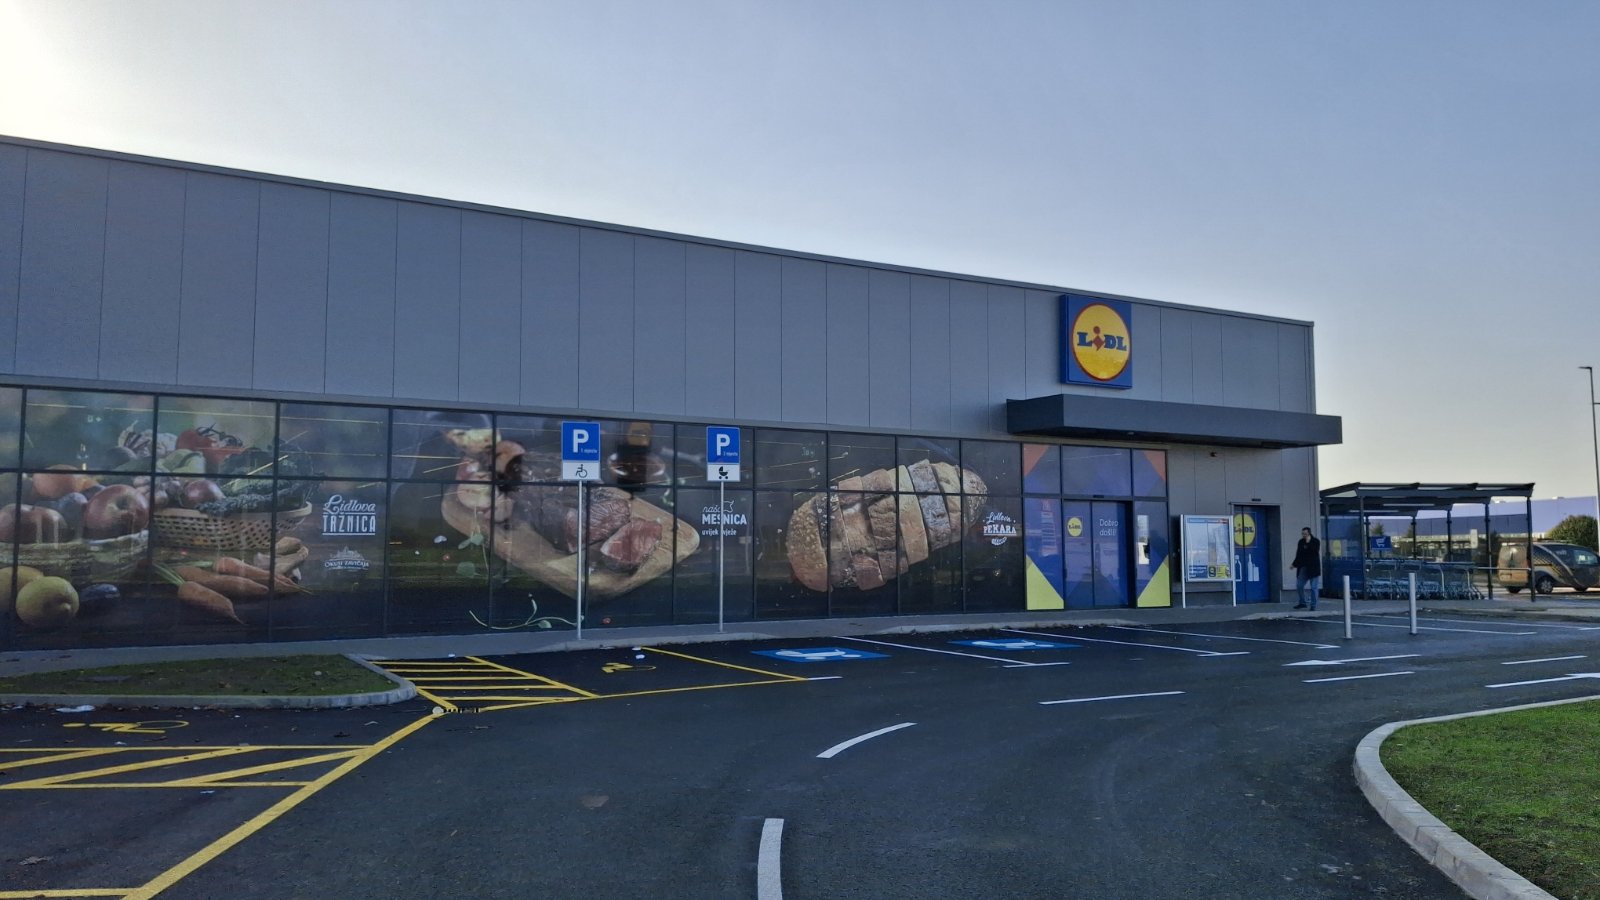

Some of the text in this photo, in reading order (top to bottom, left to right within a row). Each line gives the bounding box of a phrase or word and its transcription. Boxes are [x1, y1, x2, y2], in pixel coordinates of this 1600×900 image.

[1077, 326, 1127, 352] LIDL
[572, 428, 590, 453] P
[716, 433, 731, 456] P
[323, 495, 376, 515] Lidlova
[323, 513, 376, 533] TRŽNICA
[721, 528, 737, 537] vježe
[983, 524, 1017, 534] PEKARA
[1099, 518, 1119, 527] Dobro
